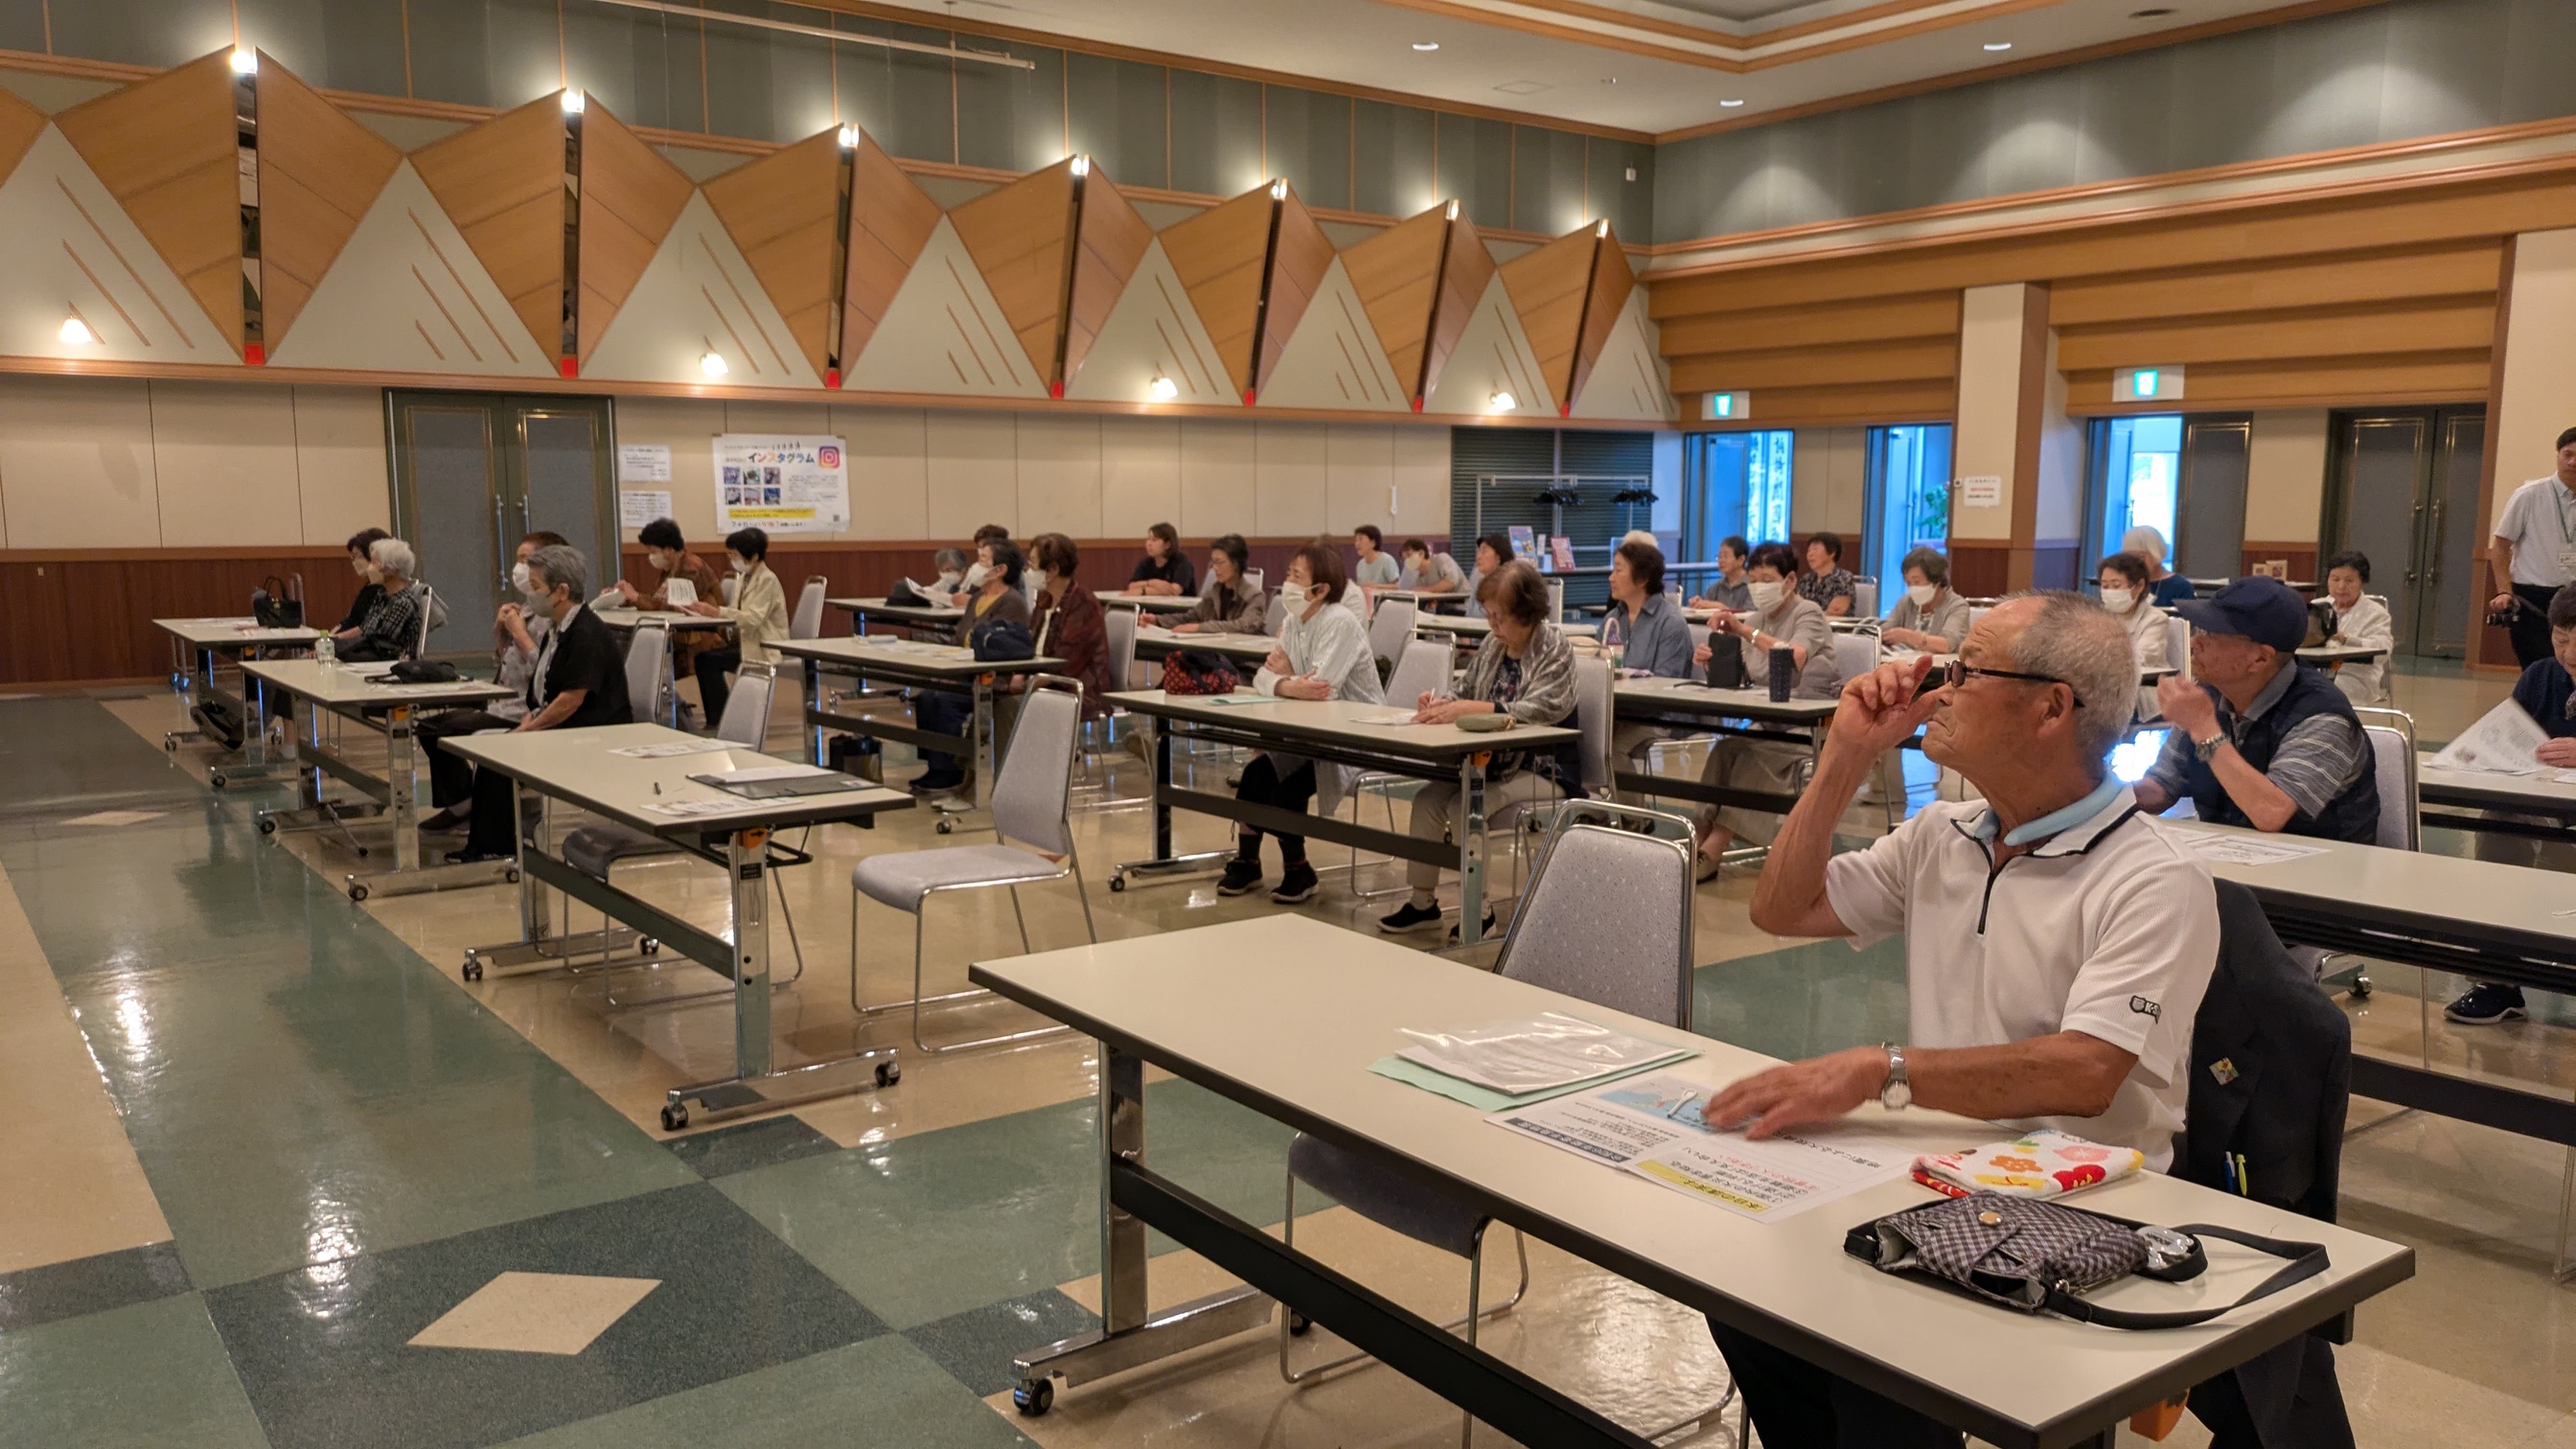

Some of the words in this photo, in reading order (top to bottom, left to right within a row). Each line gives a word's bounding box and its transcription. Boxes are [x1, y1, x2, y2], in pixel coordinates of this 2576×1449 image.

[748, 451, 815, 464] インスタグラム
